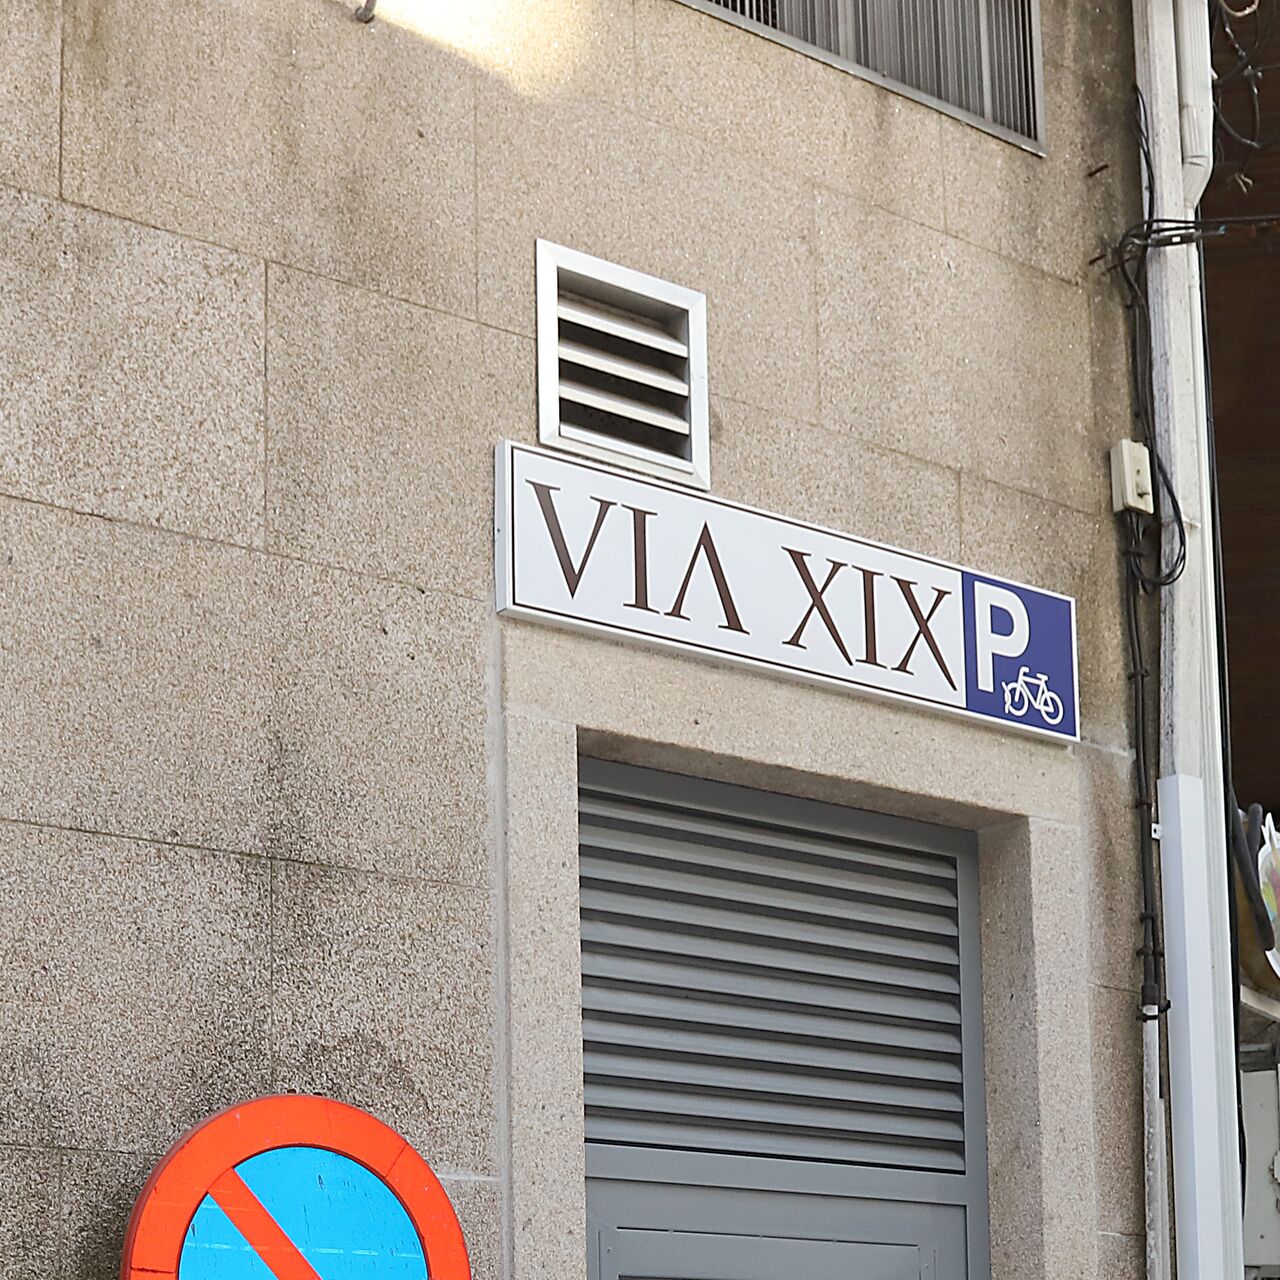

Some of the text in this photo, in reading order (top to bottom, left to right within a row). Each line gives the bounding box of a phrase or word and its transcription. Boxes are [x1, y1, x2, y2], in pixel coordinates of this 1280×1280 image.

[525, 478, 958, 692] VIA XIX
[973, 580, 1031, 693] P
